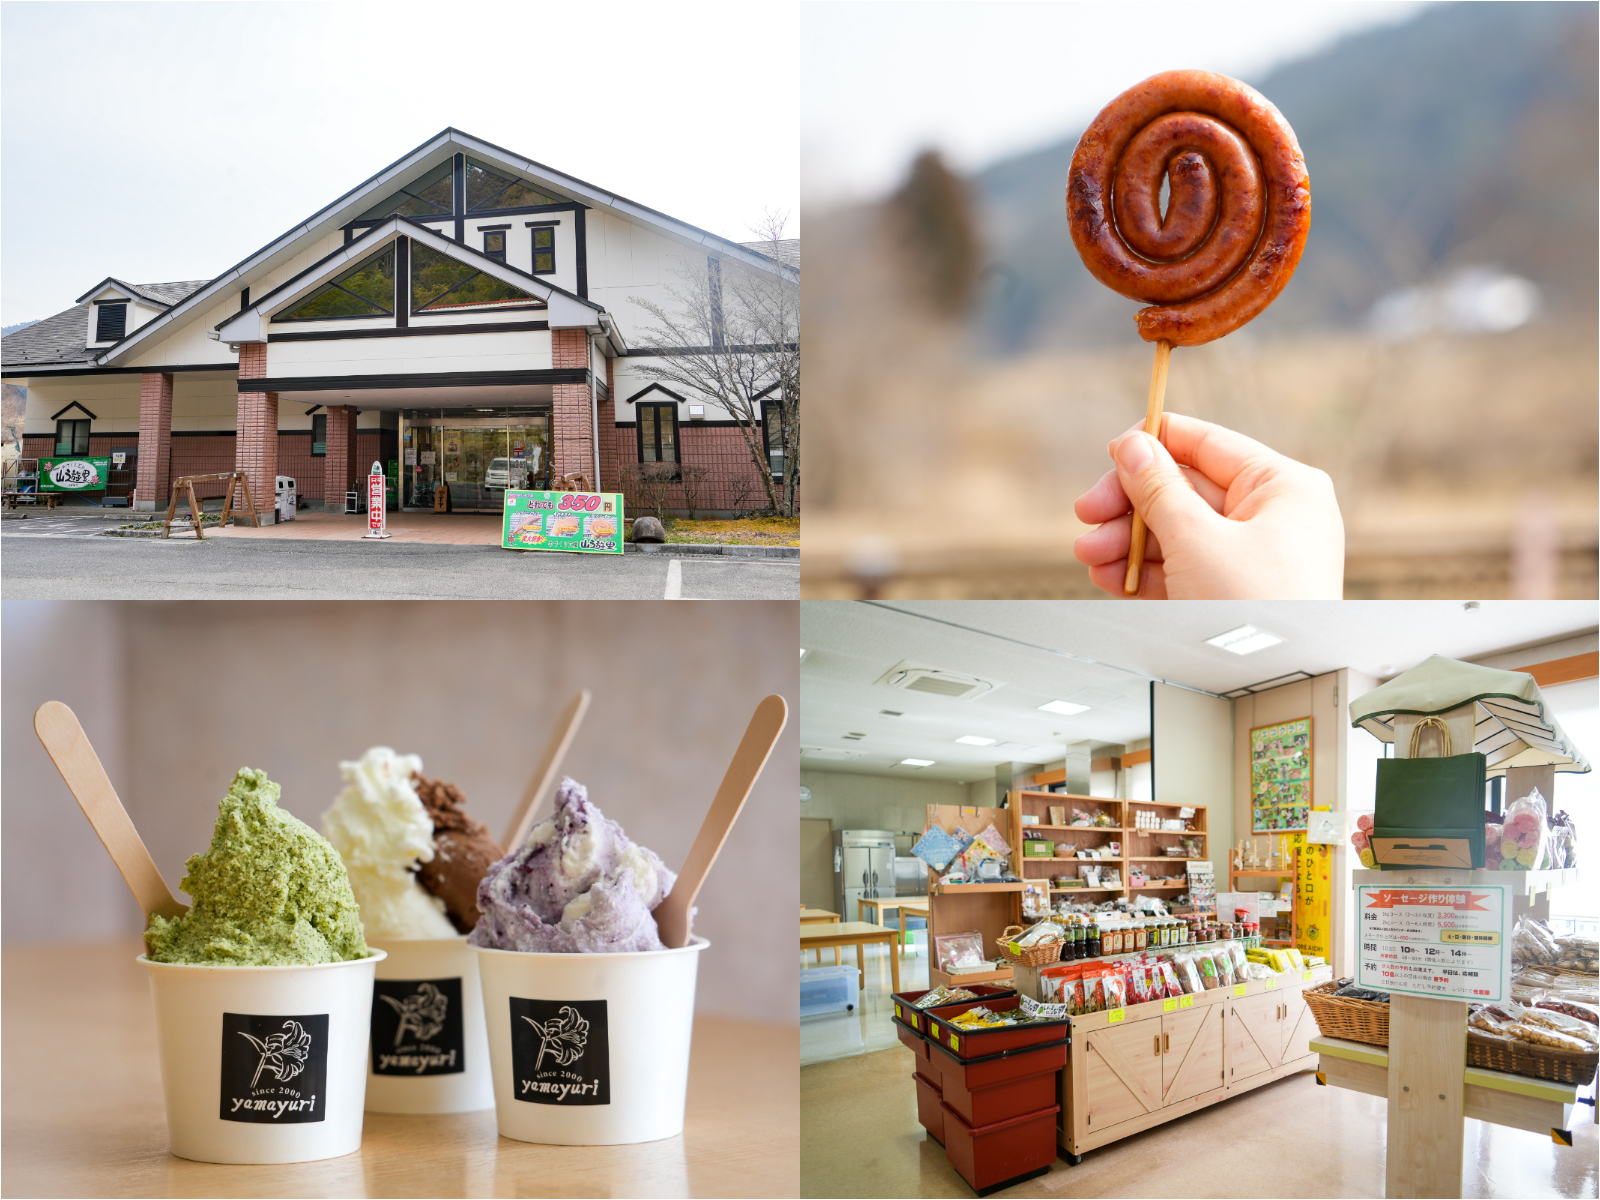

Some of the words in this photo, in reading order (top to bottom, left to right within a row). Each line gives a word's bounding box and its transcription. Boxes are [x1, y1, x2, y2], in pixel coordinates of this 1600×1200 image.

[527, 499, 555, 509] どれでも
[1383, 893, 1466, 904] ソーセージ作り体験
[1364, 912, 1377, 921] 料金
[1364, 943, 1377, 951] 時間
[1364, 962, 1377, 971] 予約
[379, 1049, 457, 1073] yamayuri
[536, 1071, 557, 1079] since
[560, 1070, 583, 1082] 2000
[251, 1087, 275, 1097] since
[278, 1086, 301, 1099] 2000
[521, 1079, 599, 1101] yamayuri
[230, 1094, 316, 1118] yamayuri
